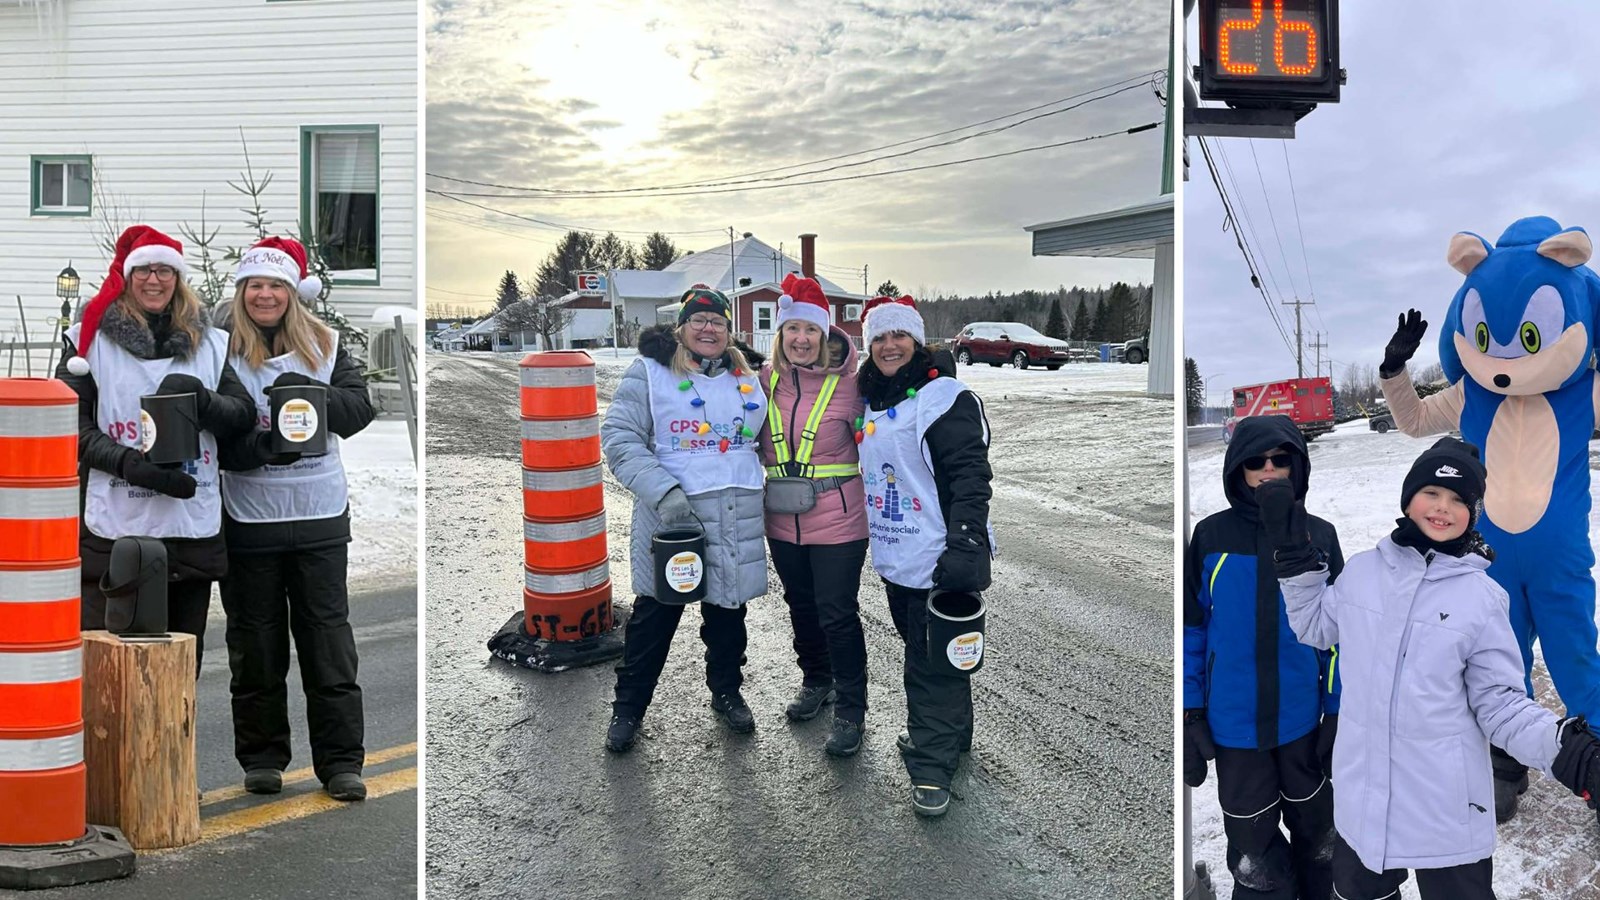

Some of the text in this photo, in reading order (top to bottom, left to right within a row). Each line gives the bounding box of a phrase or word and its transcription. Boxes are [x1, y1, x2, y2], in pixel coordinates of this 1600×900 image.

[1219, 0, 1317, 75] 26
[108, 421, 137, 441] CPS
[670, 420, 729, 433] CPS es
[1440, 465, 1459, 475] NIKE
[891, 525, 920, 535] sociale
